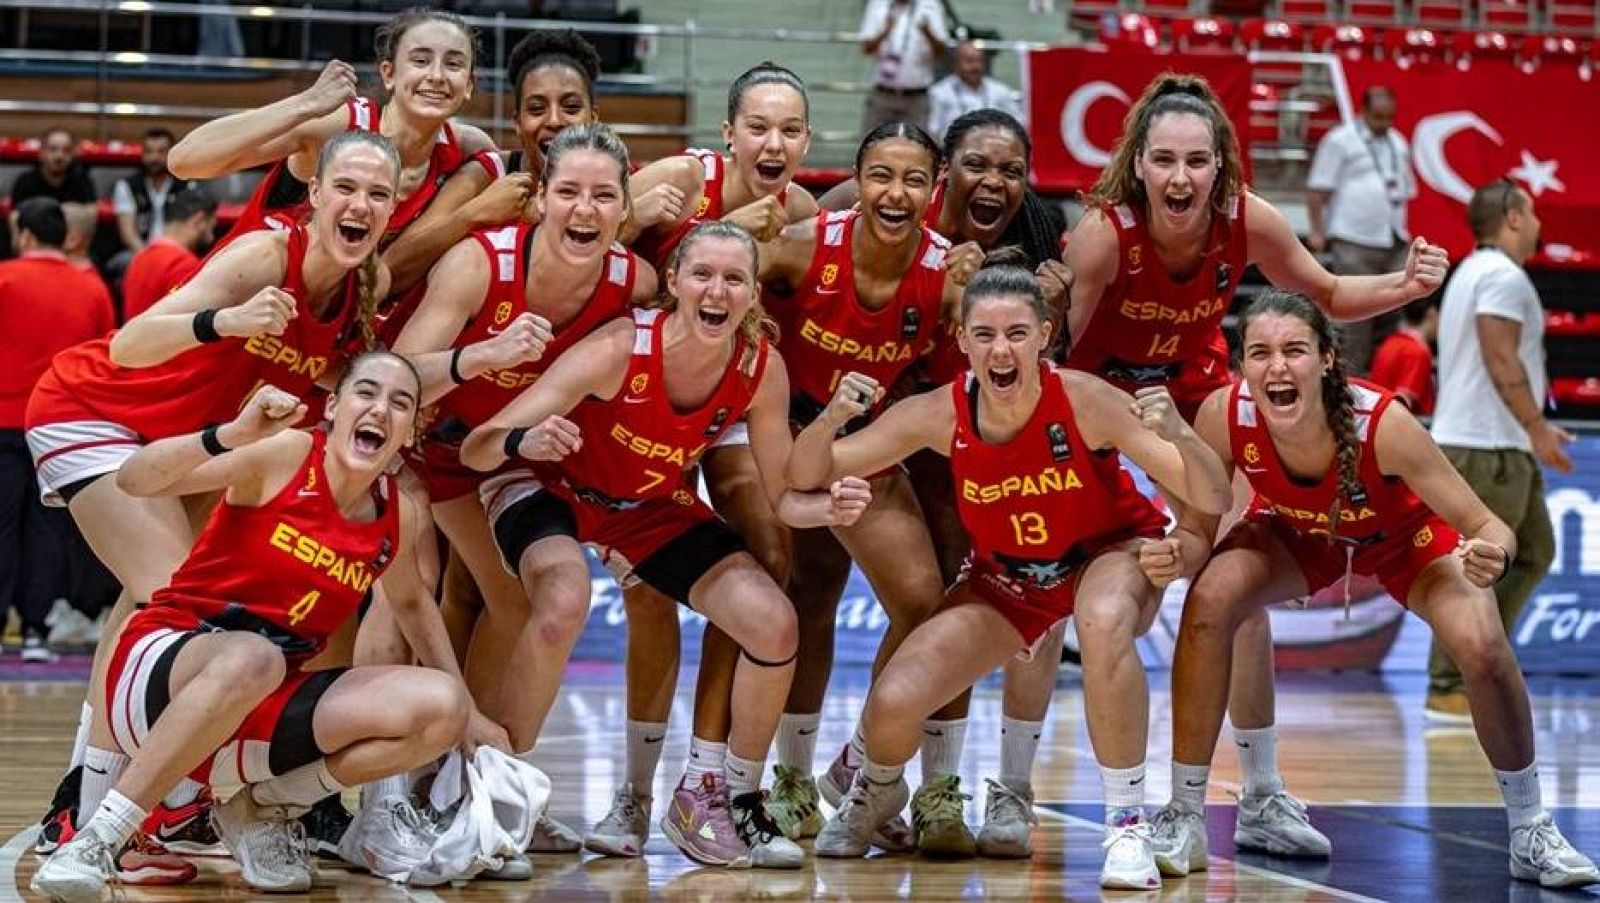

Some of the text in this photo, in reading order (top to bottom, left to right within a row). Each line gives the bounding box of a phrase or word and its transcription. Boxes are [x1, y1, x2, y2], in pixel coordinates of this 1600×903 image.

[1121, 297, 1224, 325] ESPAÑA
[800, 318, 912, 363] ESPAÑA
[1146, 333, 1181, 357] 14
[610, 421, 707, 467] ESPA
[636, 470, 667, 494] 7
[963, 467, 1084, 504] ESPAÑA
[1010, 512, 1049, 546] 13
[269, 521, 373, 594] ESPAÑA
[287, 590, 321, 626] 4
